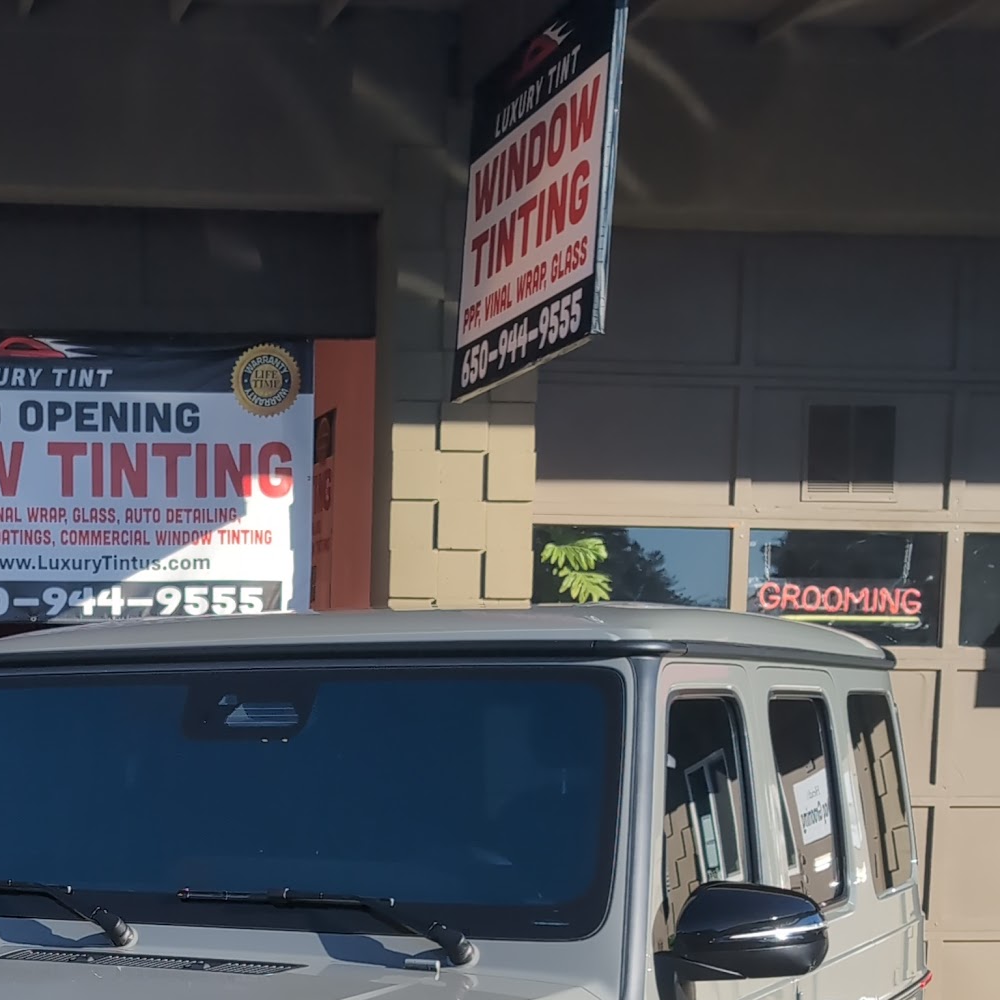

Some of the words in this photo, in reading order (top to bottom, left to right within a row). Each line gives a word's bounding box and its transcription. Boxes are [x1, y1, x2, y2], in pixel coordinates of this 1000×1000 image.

[494, 78, 543, 138] LUXURY
[547, 45, 581, 93] TINT
[475, 74, 600, 223] WINDOW
[471, 159, 590, 287] TINTING
[462, 300, 482, 335] PPF,
[485, 283, 512, 322] VINAL
[516, 262, 547, 304] WRAP,
[551, 236, 588, 284] GLASS
[461, 288, 583, 388] 650-944-9555
[51, 368, 113, 387] TINT
[244, 355, 288, 374] WARRANTY
[255, 369, 278, 379] LIFE
[253, 379, 280, 388] TIME
[19, 399, 200, 433] OPENING
[47, 441, 294, 498] TINTING
[27, 507, 68, 525] WRAP,
[73, 507, 120, 525] GLASS,
[125, 508, 161, 524] AUTO
[166, 507, 242, 524] DETAILING,
[60, 529, 150, 546] COMMERCIAL
[155, 530, 212, 546] WINDOW
[217, 529, 273, 546] TINTING
[758, 581, 923, 615] GROOMING
